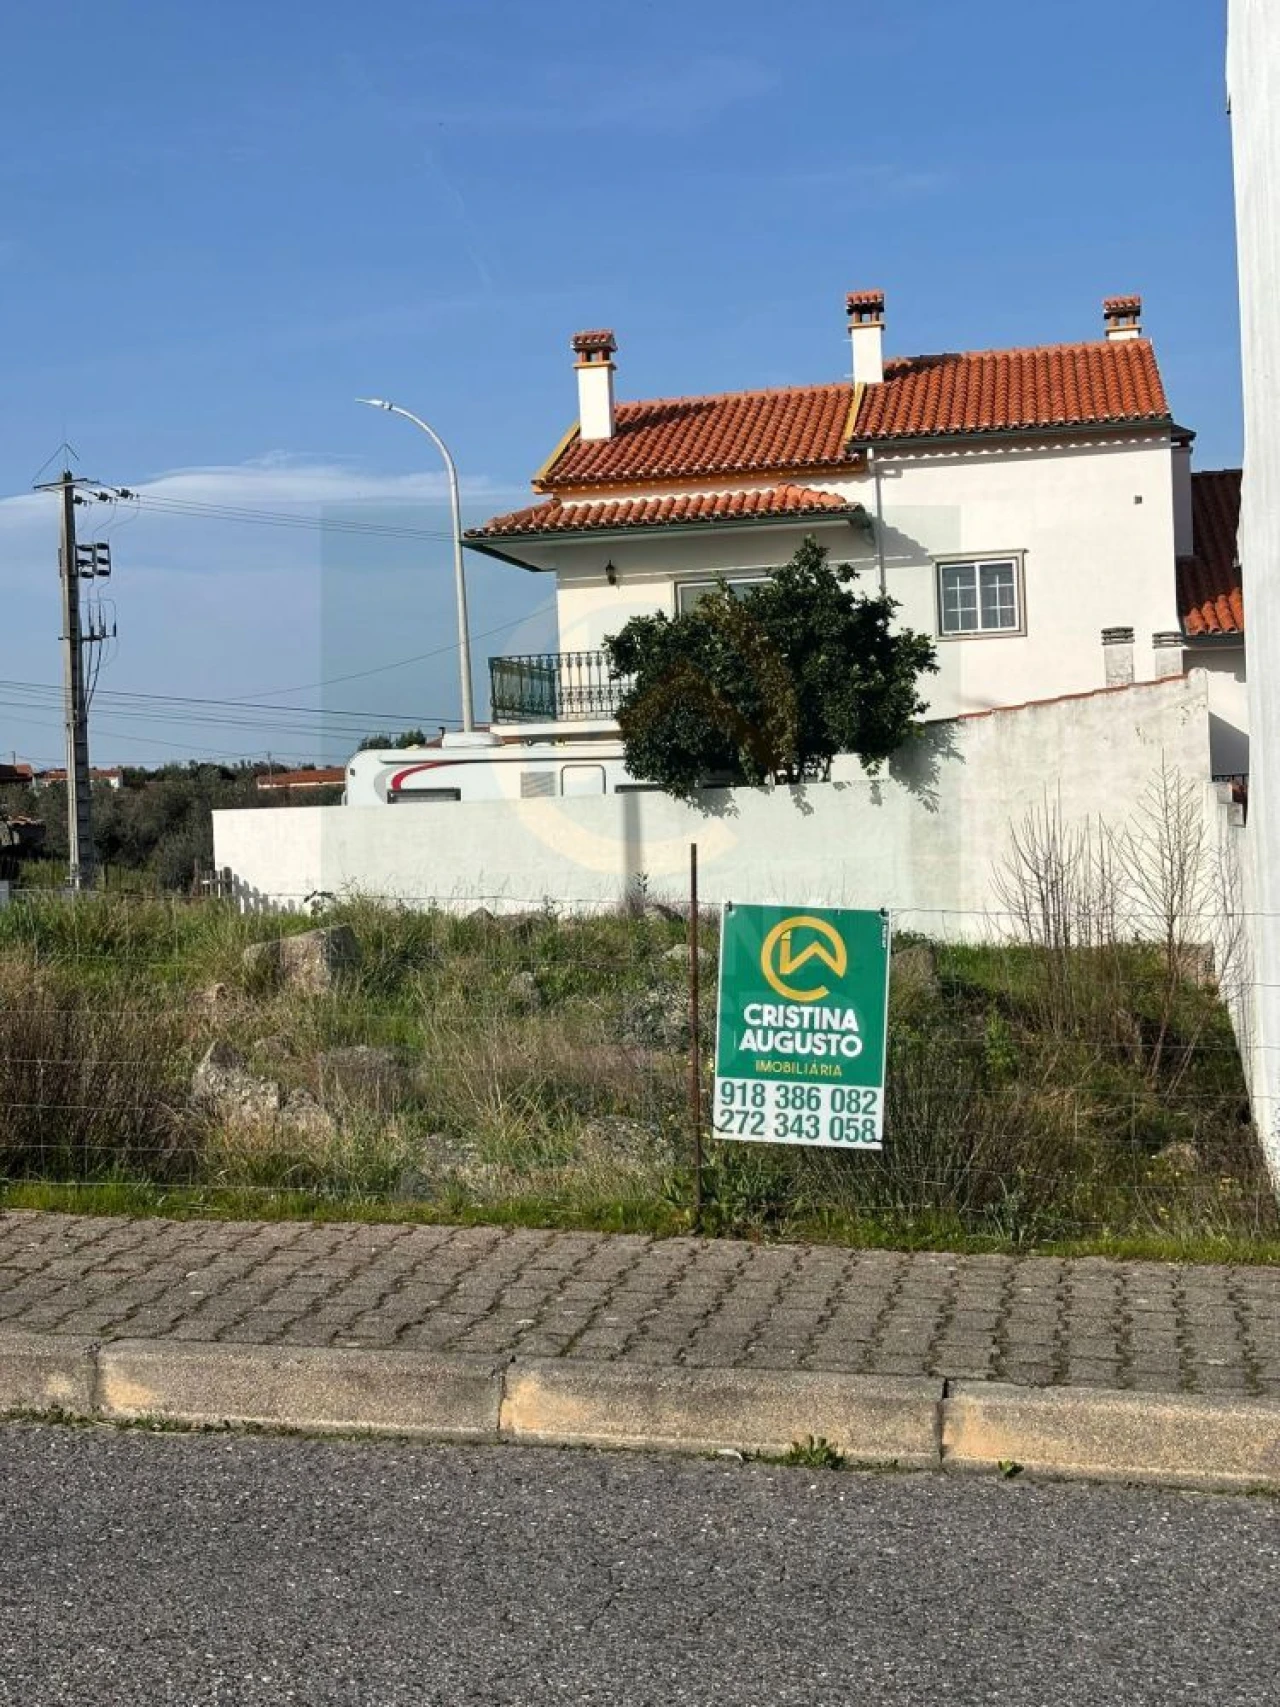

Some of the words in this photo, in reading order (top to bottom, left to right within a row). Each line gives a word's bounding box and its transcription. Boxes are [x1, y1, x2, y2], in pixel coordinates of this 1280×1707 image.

[743, 1003, 859, 1032] CRISTINA
[738, 1030, 863, 1057] AUGUSTO
[755, 1061, 842, 1077] IMOBILIÁRIA
[720, 1081, 766, 1108] 918
[775, 1084, 822, 1112] 386
[830, 1088, 878, 1115] 082
[720, 1109, 766, 1136] 272
[775, 1112, 821, 1140] 343
[830, 1116, 877, 1143] 058
